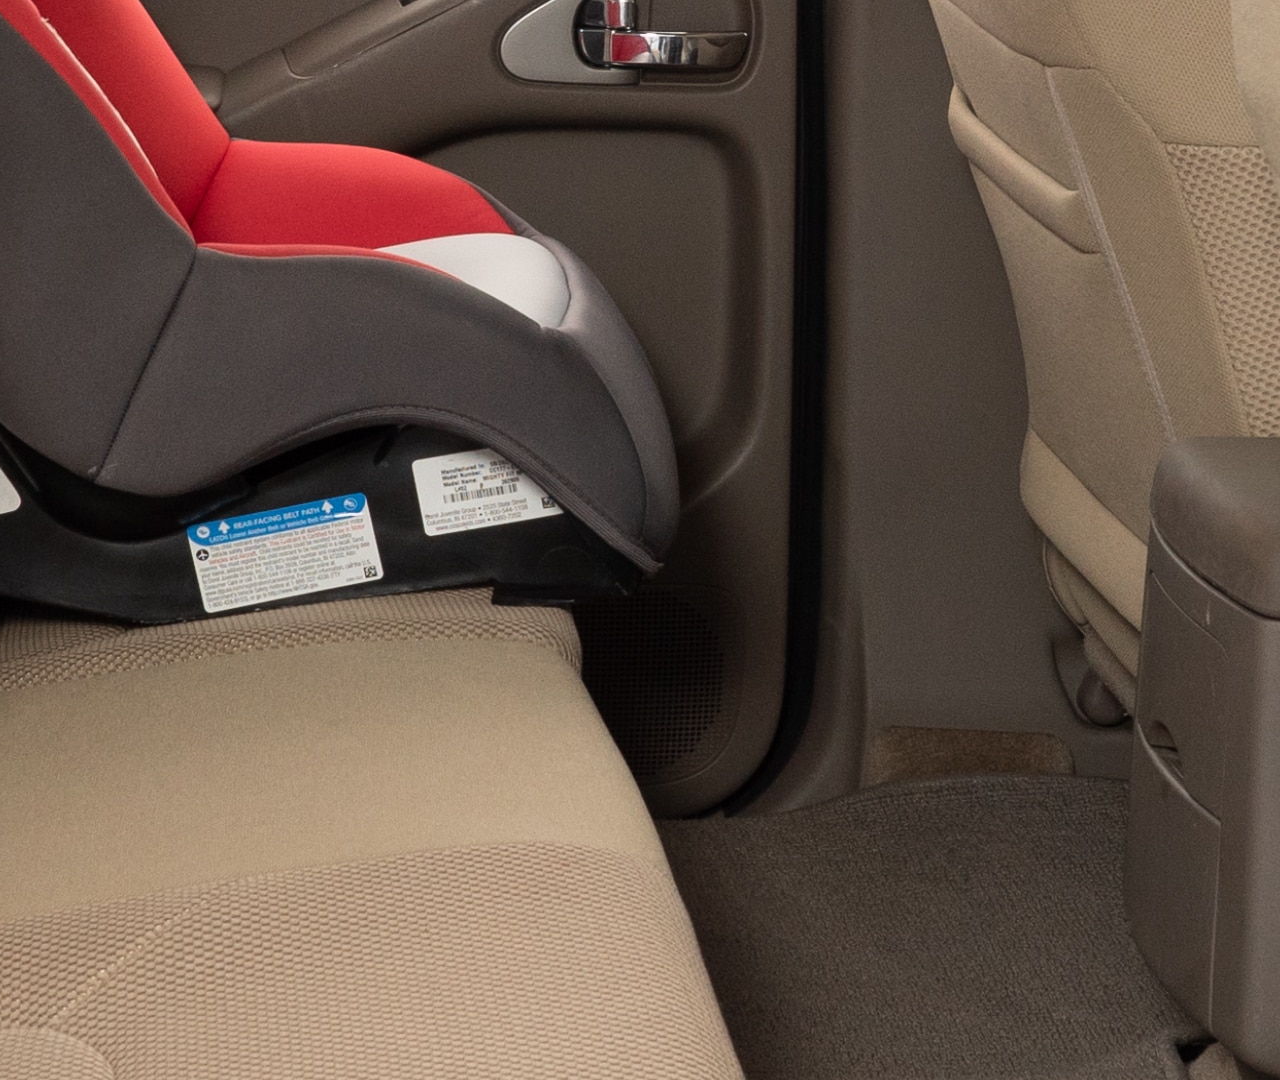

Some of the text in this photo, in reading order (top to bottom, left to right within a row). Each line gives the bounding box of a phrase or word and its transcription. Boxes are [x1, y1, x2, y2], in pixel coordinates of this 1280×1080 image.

[441, 465, 476, 474] Manufactured
[233, 507, 320, 529] REAR-FACING BELT PATH
